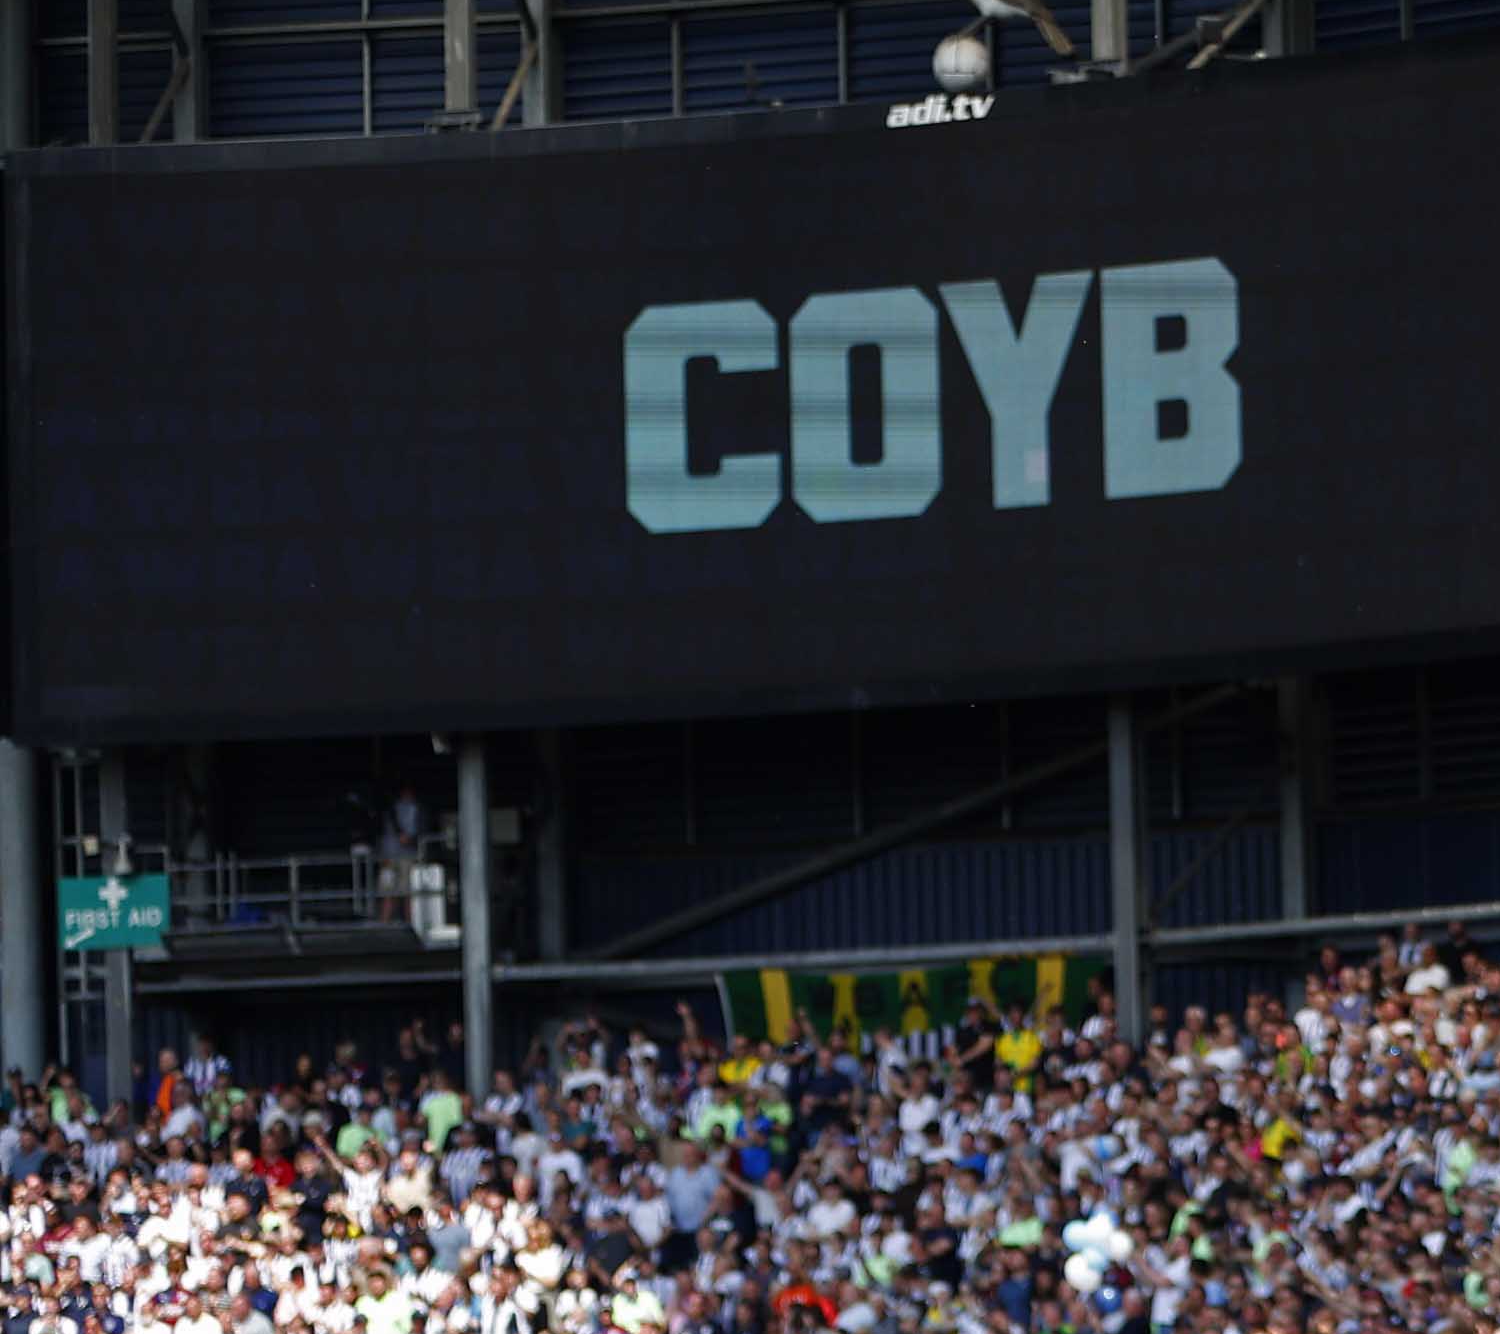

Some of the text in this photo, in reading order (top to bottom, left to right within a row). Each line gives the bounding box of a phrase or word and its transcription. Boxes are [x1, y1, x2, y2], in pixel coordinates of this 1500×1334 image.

[886, 93, 995, 127] adi.tv
[624, 255, 1243, 535] COYB
[65, 907, 161, 929] FIRST AID
